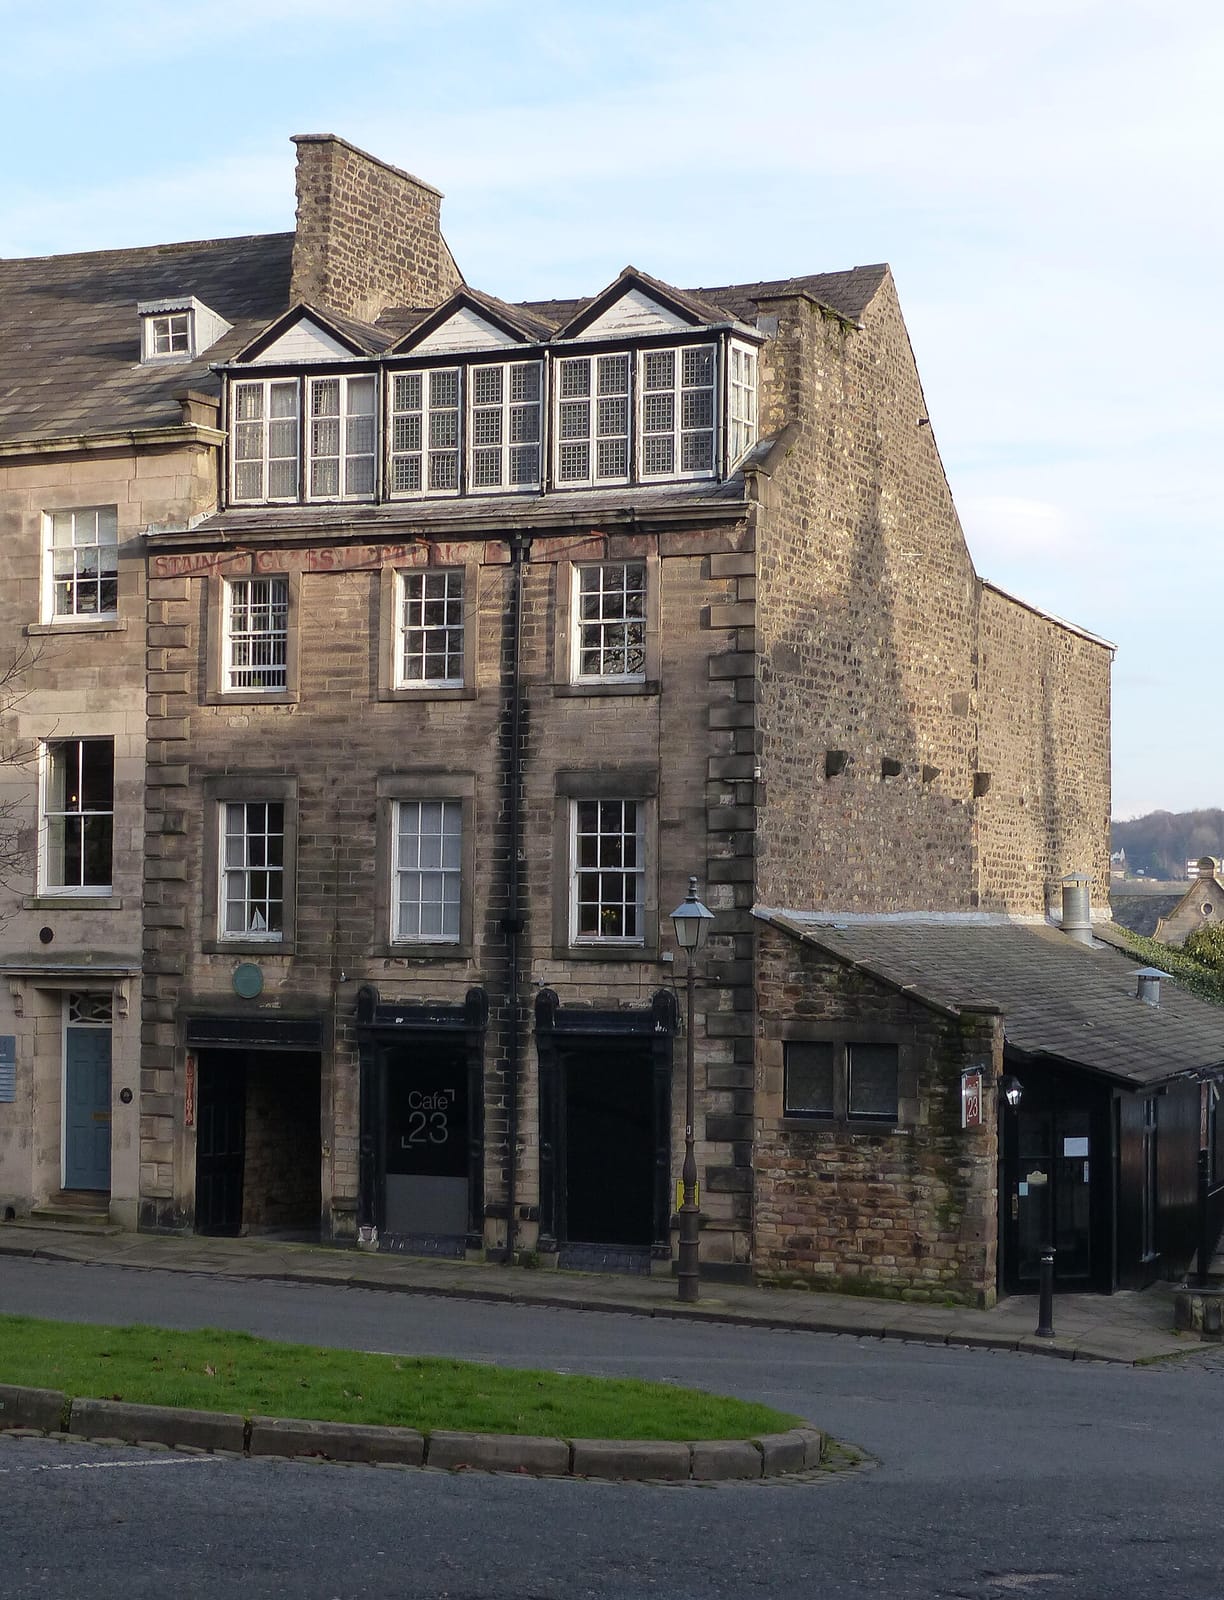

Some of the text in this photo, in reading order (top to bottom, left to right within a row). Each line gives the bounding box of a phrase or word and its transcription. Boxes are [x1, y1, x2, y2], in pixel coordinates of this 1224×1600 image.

[408, 1090, 449, 1110] Cafe
[968, 1096, 978, 1118] 23
[408, 1111, 449, 1144] 23
